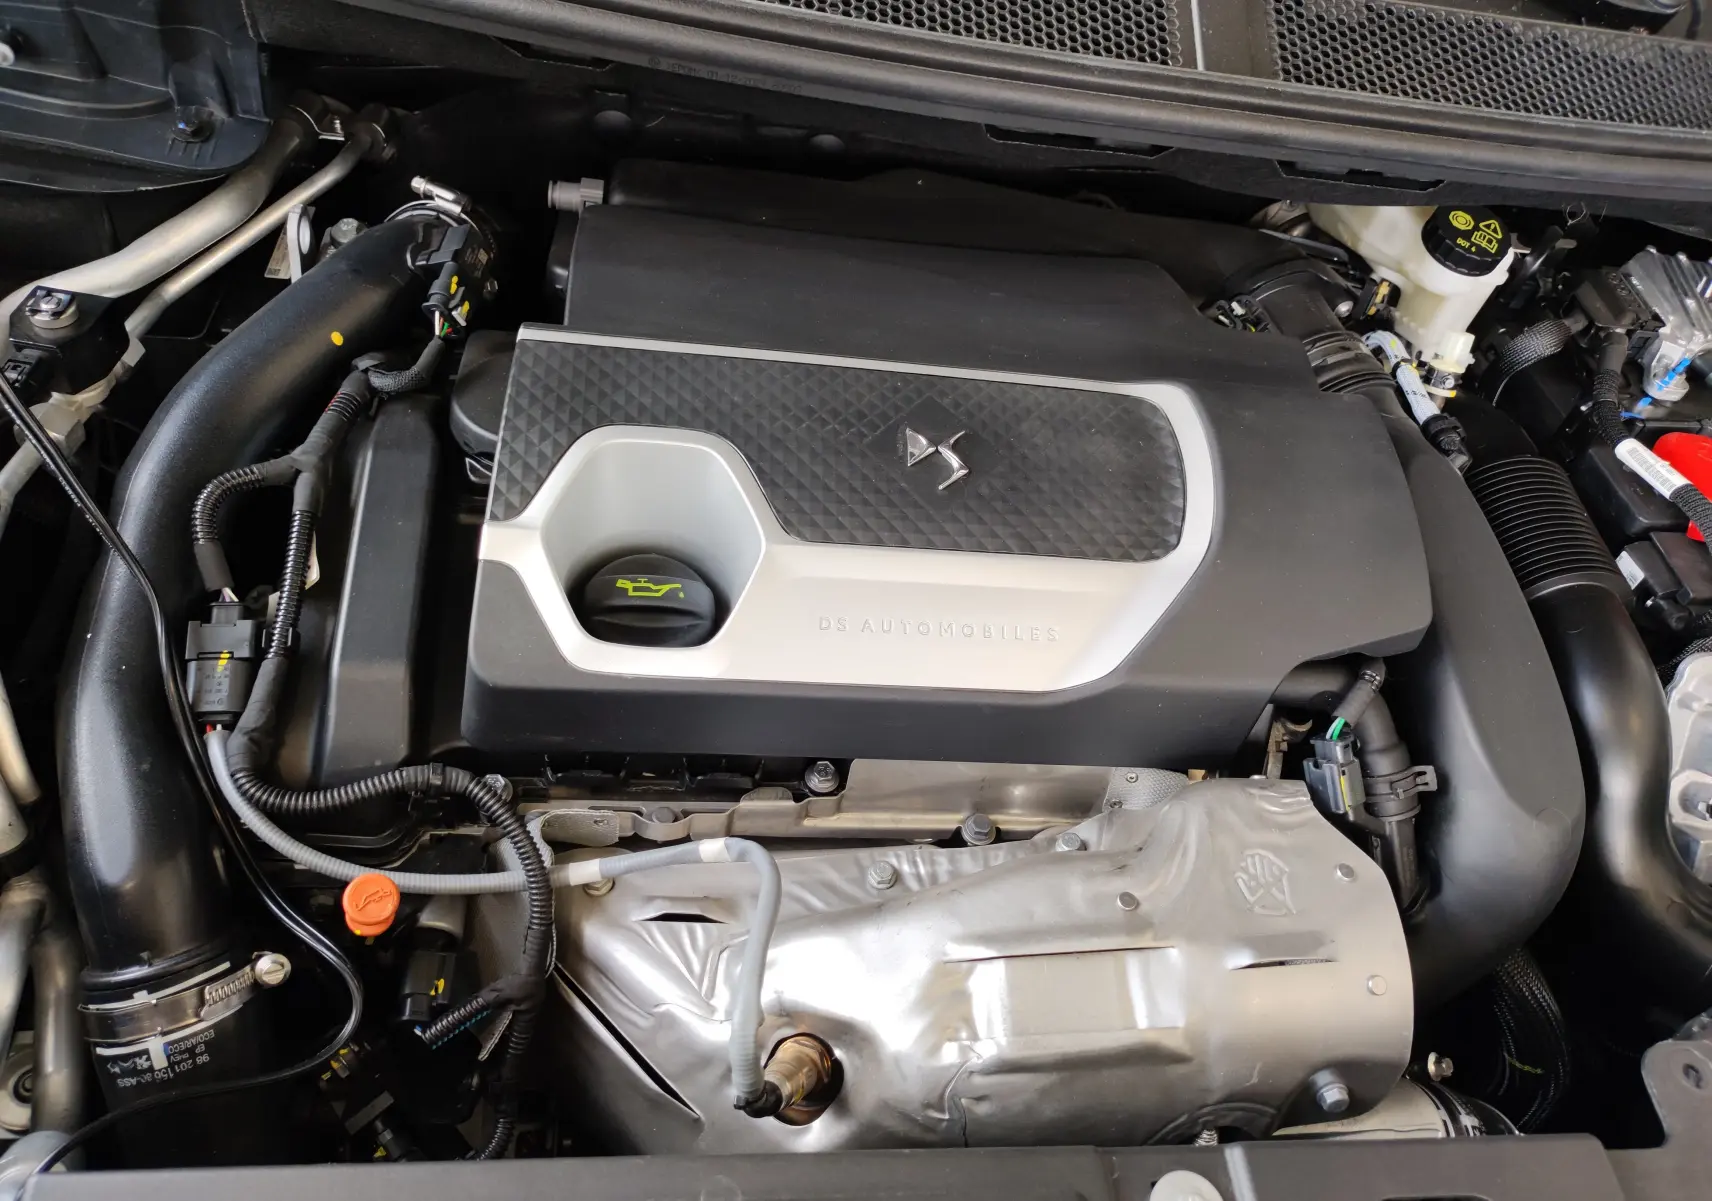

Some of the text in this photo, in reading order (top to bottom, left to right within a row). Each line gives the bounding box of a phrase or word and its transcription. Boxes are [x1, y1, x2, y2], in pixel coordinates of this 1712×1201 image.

[1457, 237, 1470, 248] DOT
[819, 615, 1060, 642] DS AUTOMOBILES
[167, 1029, 215, 1054] ECO/AR/ECO
[194, 1043, 206, 1054] EP
[174, 1059, 194, 1072] 201
[195, 1054, 210, 1065] 98
